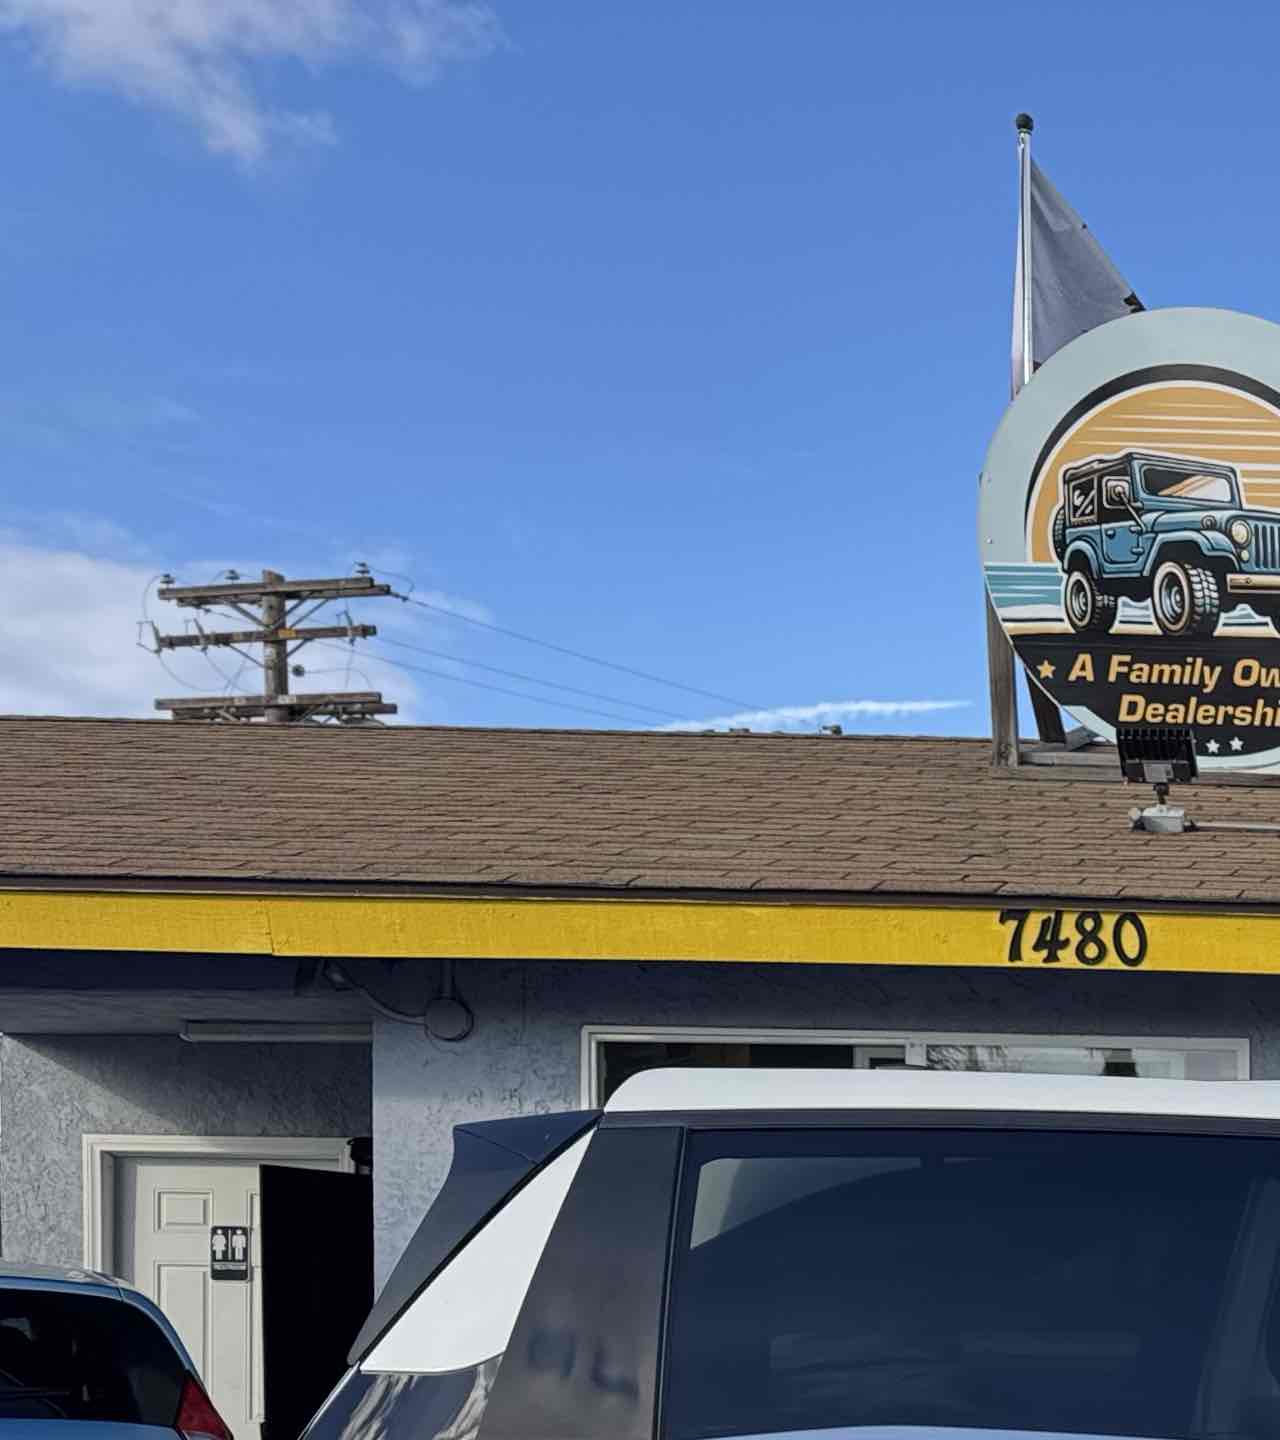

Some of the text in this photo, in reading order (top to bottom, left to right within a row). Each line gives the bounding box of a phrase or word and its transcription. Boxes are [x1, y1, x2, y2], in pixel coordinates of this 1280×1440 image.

[1068, 653, 1095, 682] A
[1107, 654, 1222, 694] Family
[999, 908, 1148, 967] 7480
